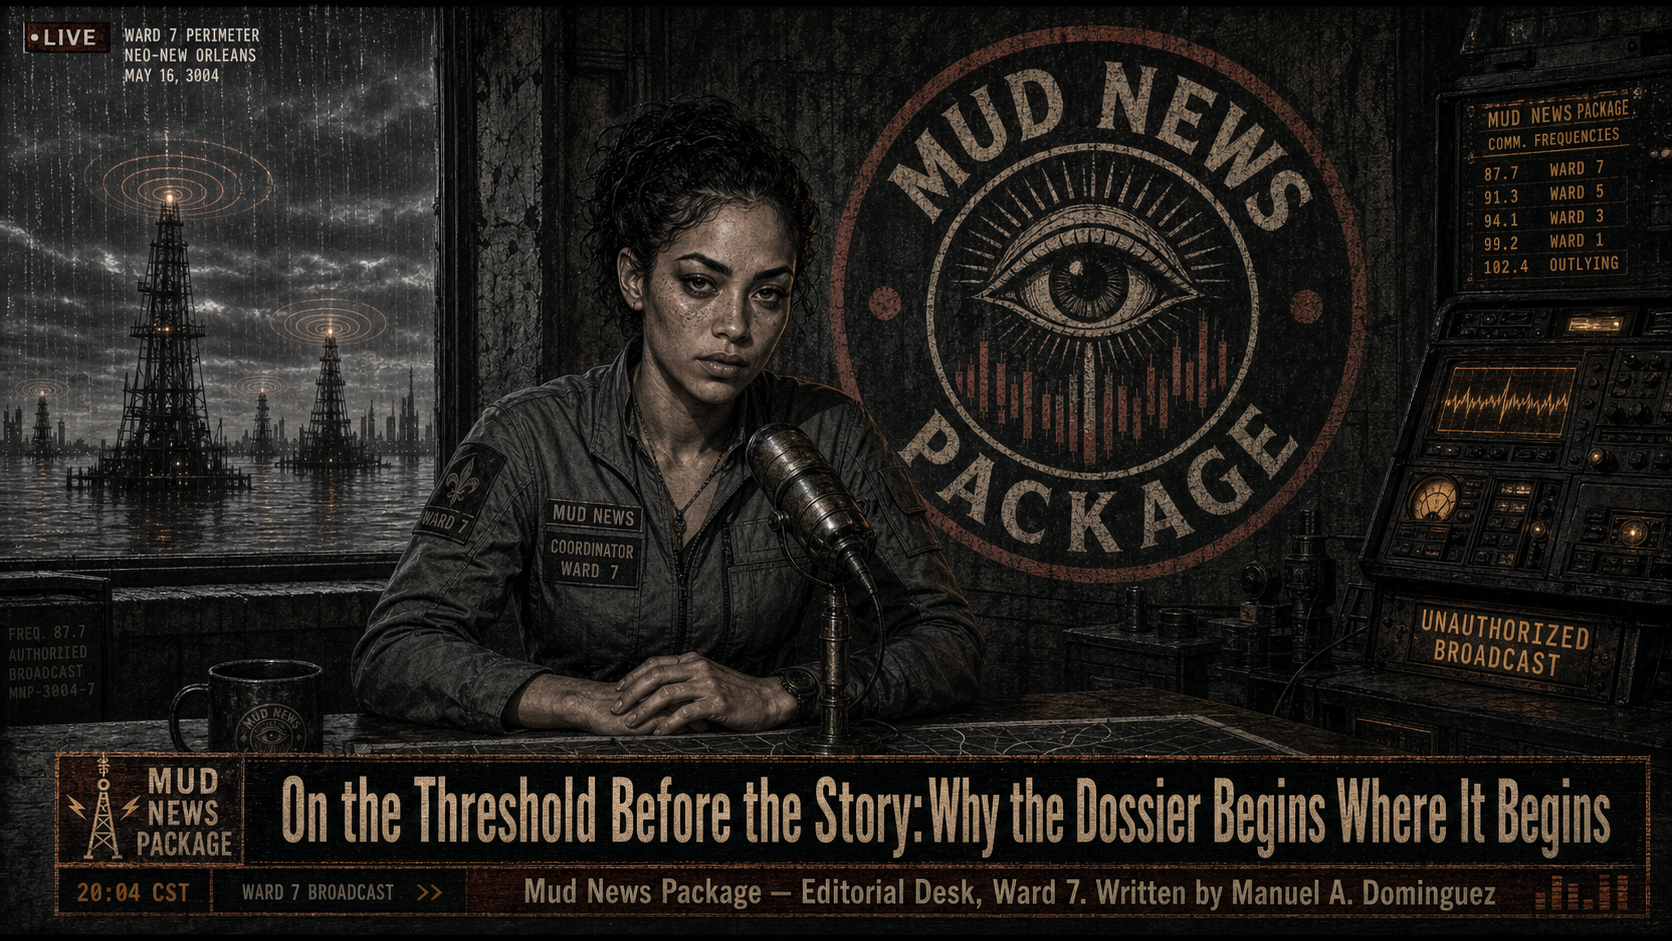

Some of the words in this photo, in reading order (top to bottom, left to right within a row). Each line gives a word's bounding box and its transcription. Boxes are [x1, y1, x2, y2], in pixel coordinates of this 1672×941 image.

[1487, 109, 1521, 129] MUD
[1531, 104, 1573, 124] NEWS
[1577, 99, 1629, 118] PACKAGE
[888, 68, 1064, 225] MUD
[1097, 61, 1313, 232] NEWS
[1488, 135, 1527, 152] COMM.
[1535, 127, 1619, 147] FREQUENCIES
[1484, 164, 1519, 182] 87.7
[1549, 160, 1585, 177] WARD
[1596, 159, 1604, 174] 7
[1484, 188, 1519, 205] 91.3
[1549, 184, 1585, 201] WARD
[1596, 183, 1604, 199] 5
[1484, 212, 1518, 229] 94.1
[1549, 209, 1585, 225] WARD
[1596, 208, 1604, 224] 3
[1484, 235, 1518, 252] 99.2
[1549, 233, 1585, 249] WARD
[1596, 232, 1604, 247] 1
[1484, 259, 1529, 275] 102.4
[1549, 254, 1619, 272] OUTLYING
[898, 403, 1299, 553] PACKAGE
[422, 511, 455, 530] WARD
[457, 518, 469, 534] 7
[552, 503, 587, 523] MUD
[593, 507, 635, 527] NEWS
[550, 538, 634, 560] COORDINATOR
[560, 560, 600, 579] WARD
[610, 564, 619, 580] 7
[8, 625, 46, 642] FREQ.
[53, 623, 86, 640] 87.7
[1421, 609, 1589, 650] UNAUTHORIZED
[1434, 638, 1560, 676] BROADCAST
[8, 663, 84, 681] BROADCAST
[8, 681, 95, 700] MNP-3004-7
[243, 708, 268, 730] MUD
[271, 706, 302, 731] NEWS
